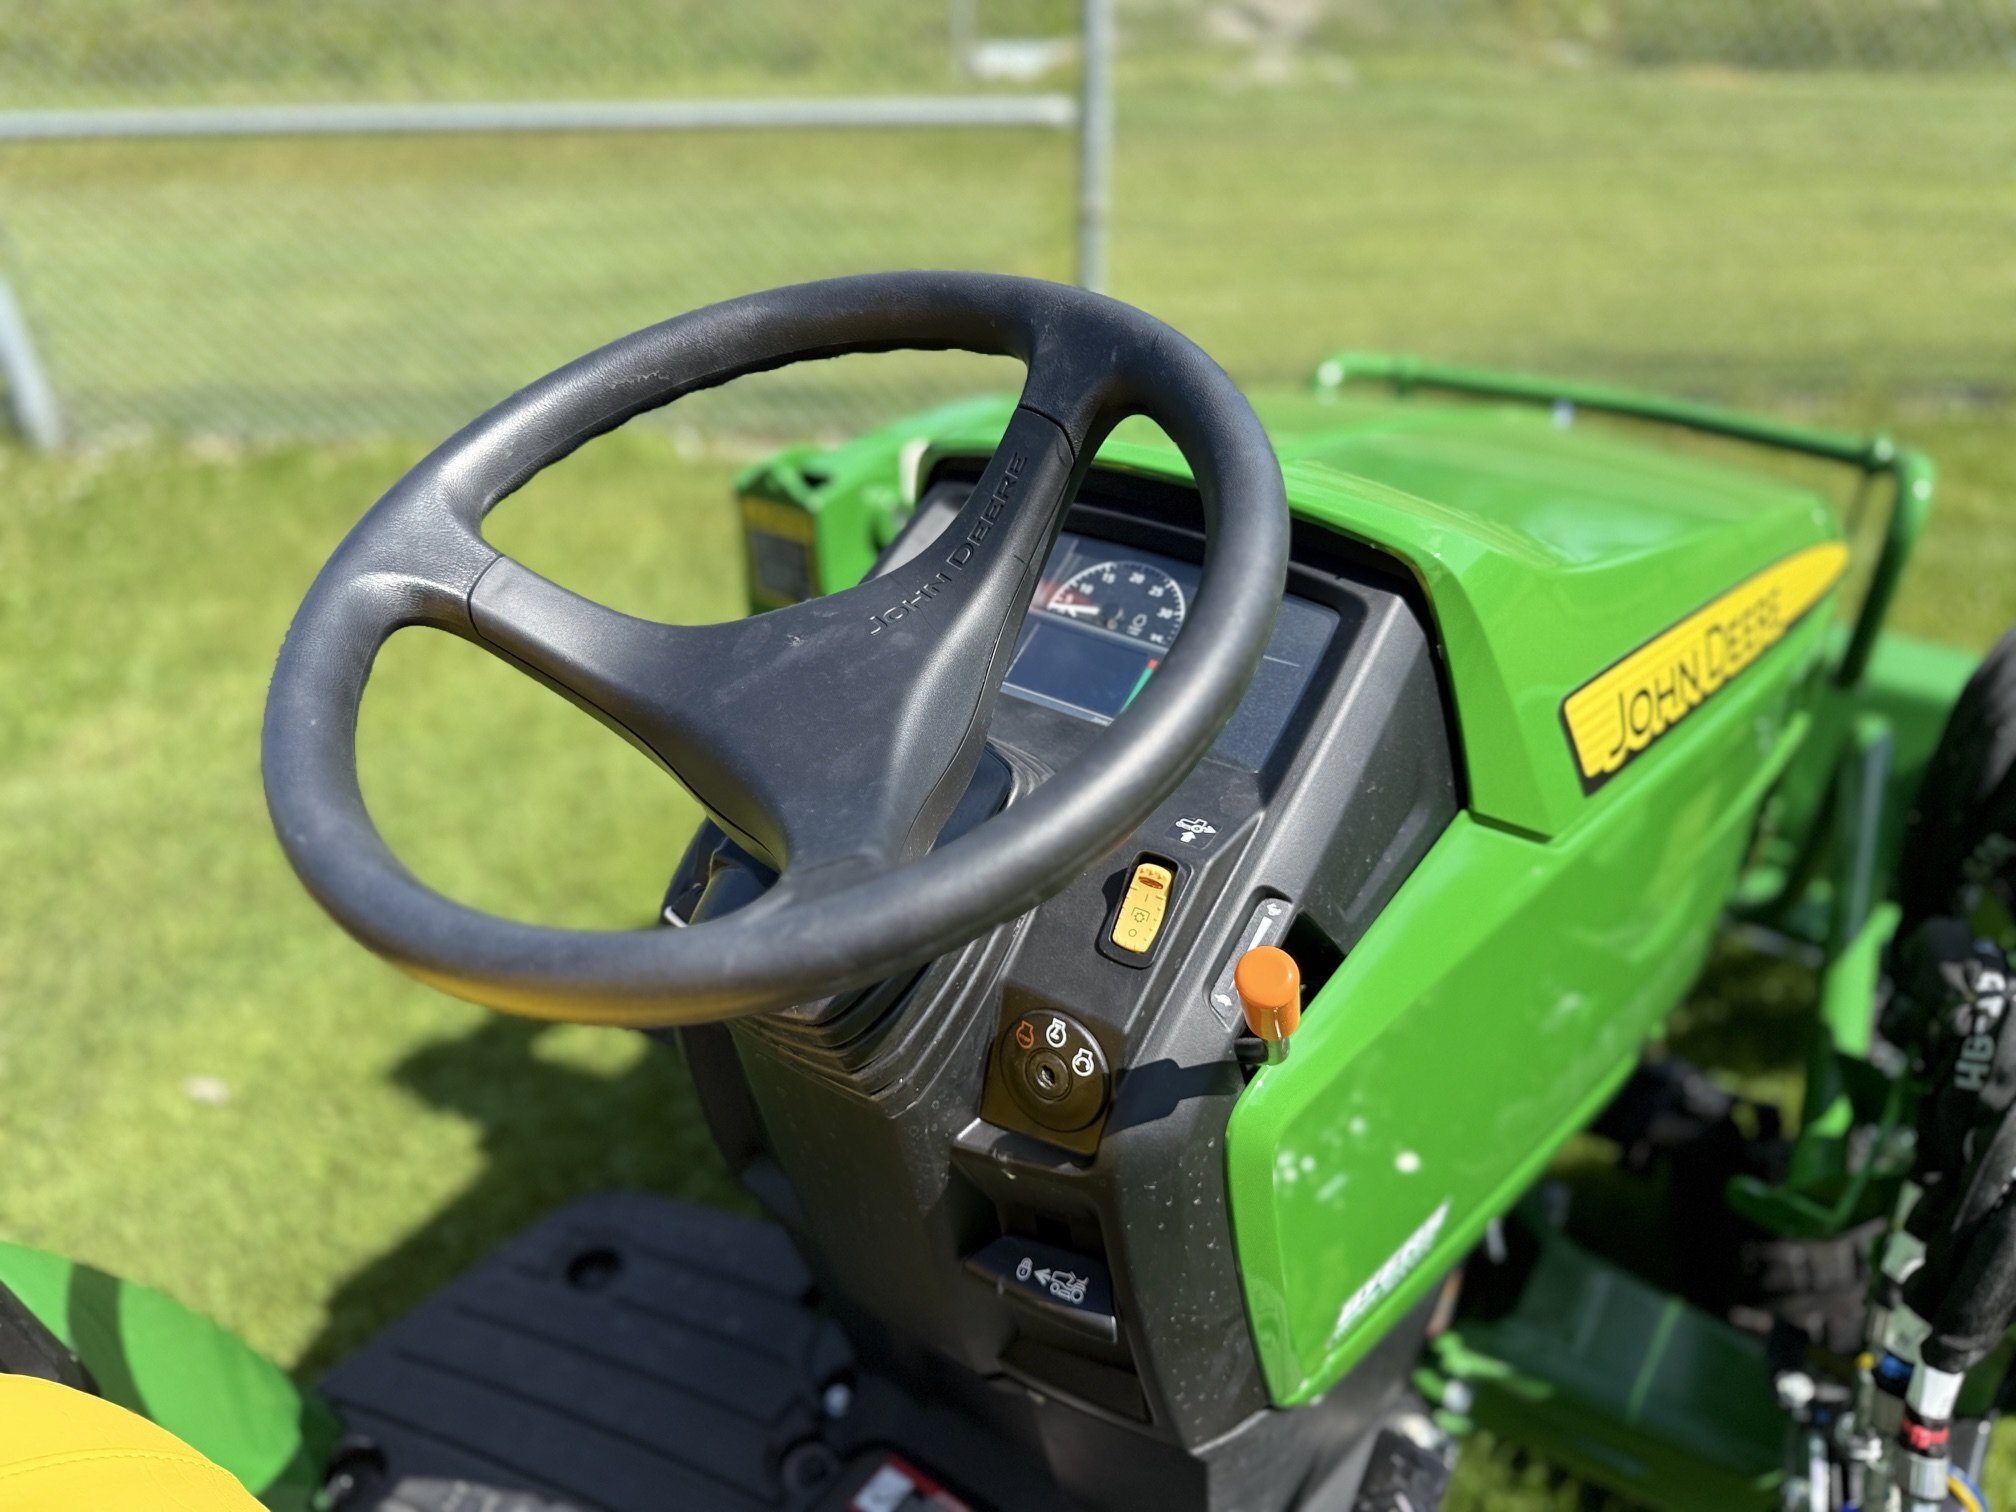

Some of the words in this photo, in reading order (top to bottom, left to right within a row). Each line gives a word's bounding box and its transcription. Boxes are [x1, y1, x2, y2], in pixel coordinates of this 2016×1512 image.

[870, 572, 953, 636] JOHN
[946, 451, 1028, 571] DEERE
[1128, 571, 1146, 585] 20
[1148, 584, 1164, 598] 25
[1608, 648, 1703, 758] JOHN
[1703, 585, 1783, 680] DEERE
